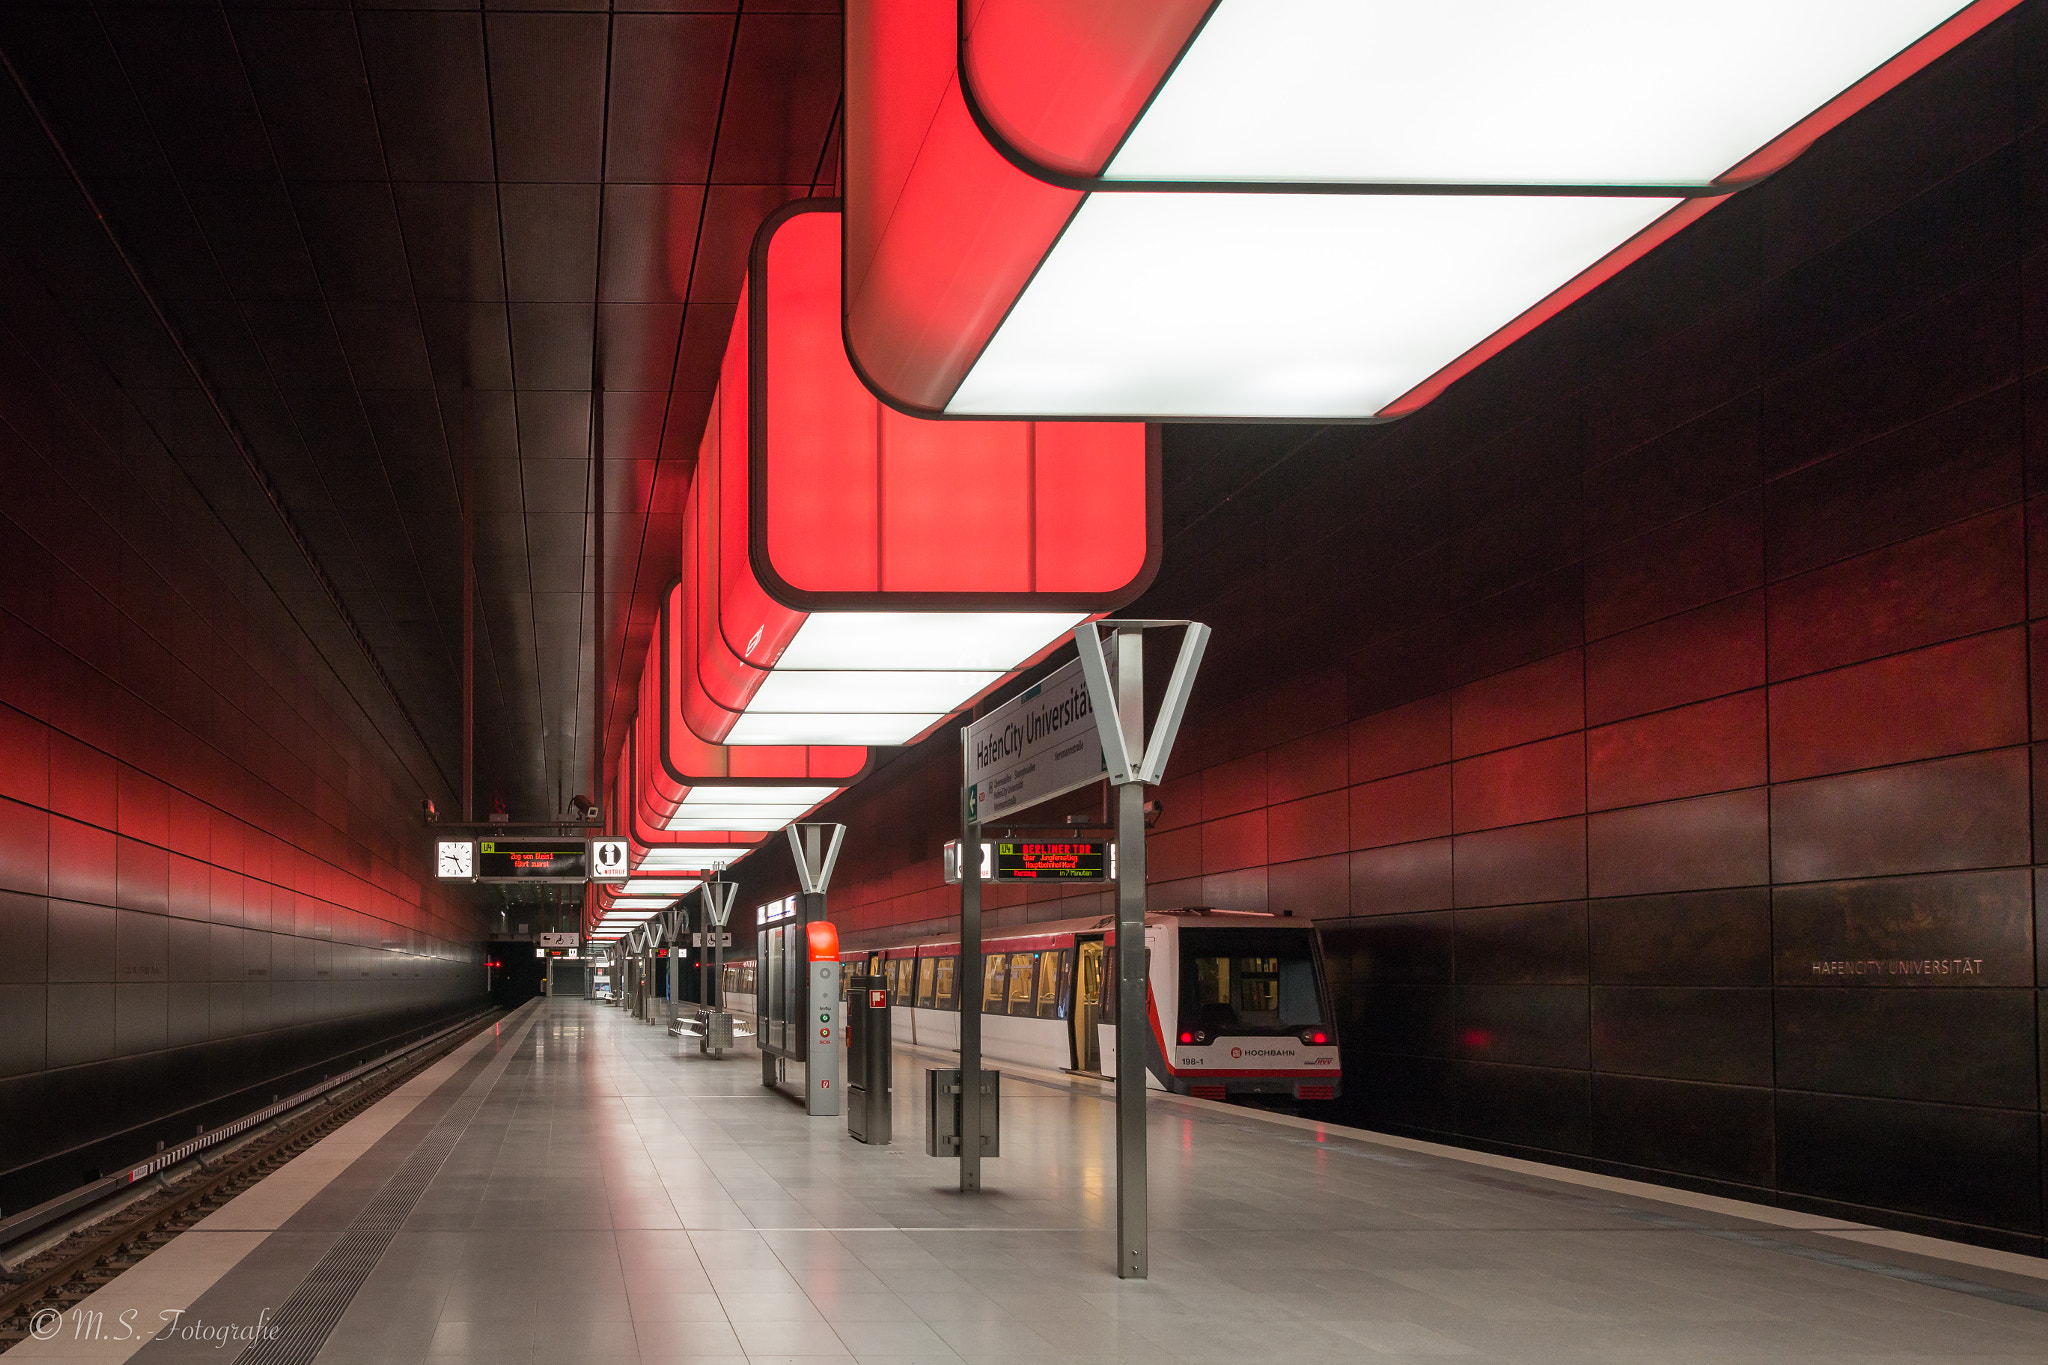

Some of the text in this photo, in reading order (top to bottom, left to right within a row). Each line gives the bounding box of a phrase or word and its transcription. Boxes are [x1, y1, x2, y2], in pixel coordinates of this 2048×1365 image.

[977, 722, 1024, 771] HafenCity
[483, 843, 493, 852] U4
[1001, 845, 1012, 853] U4
[1022, 843, 1091, 854] BERLINER TOR
[510, 852, 522, 861] Zug
[1040, 854, 1078, 863] Jungfernstieg
[531, 860, 550, 868] zuerst
[1812, 957, 1983, 975] HAFENCITY UNIVERSITÄT
[1244, 1049, 1295, 1057] HOCHBAHN
[1181, 1058, 1204, 1066] 198-1
